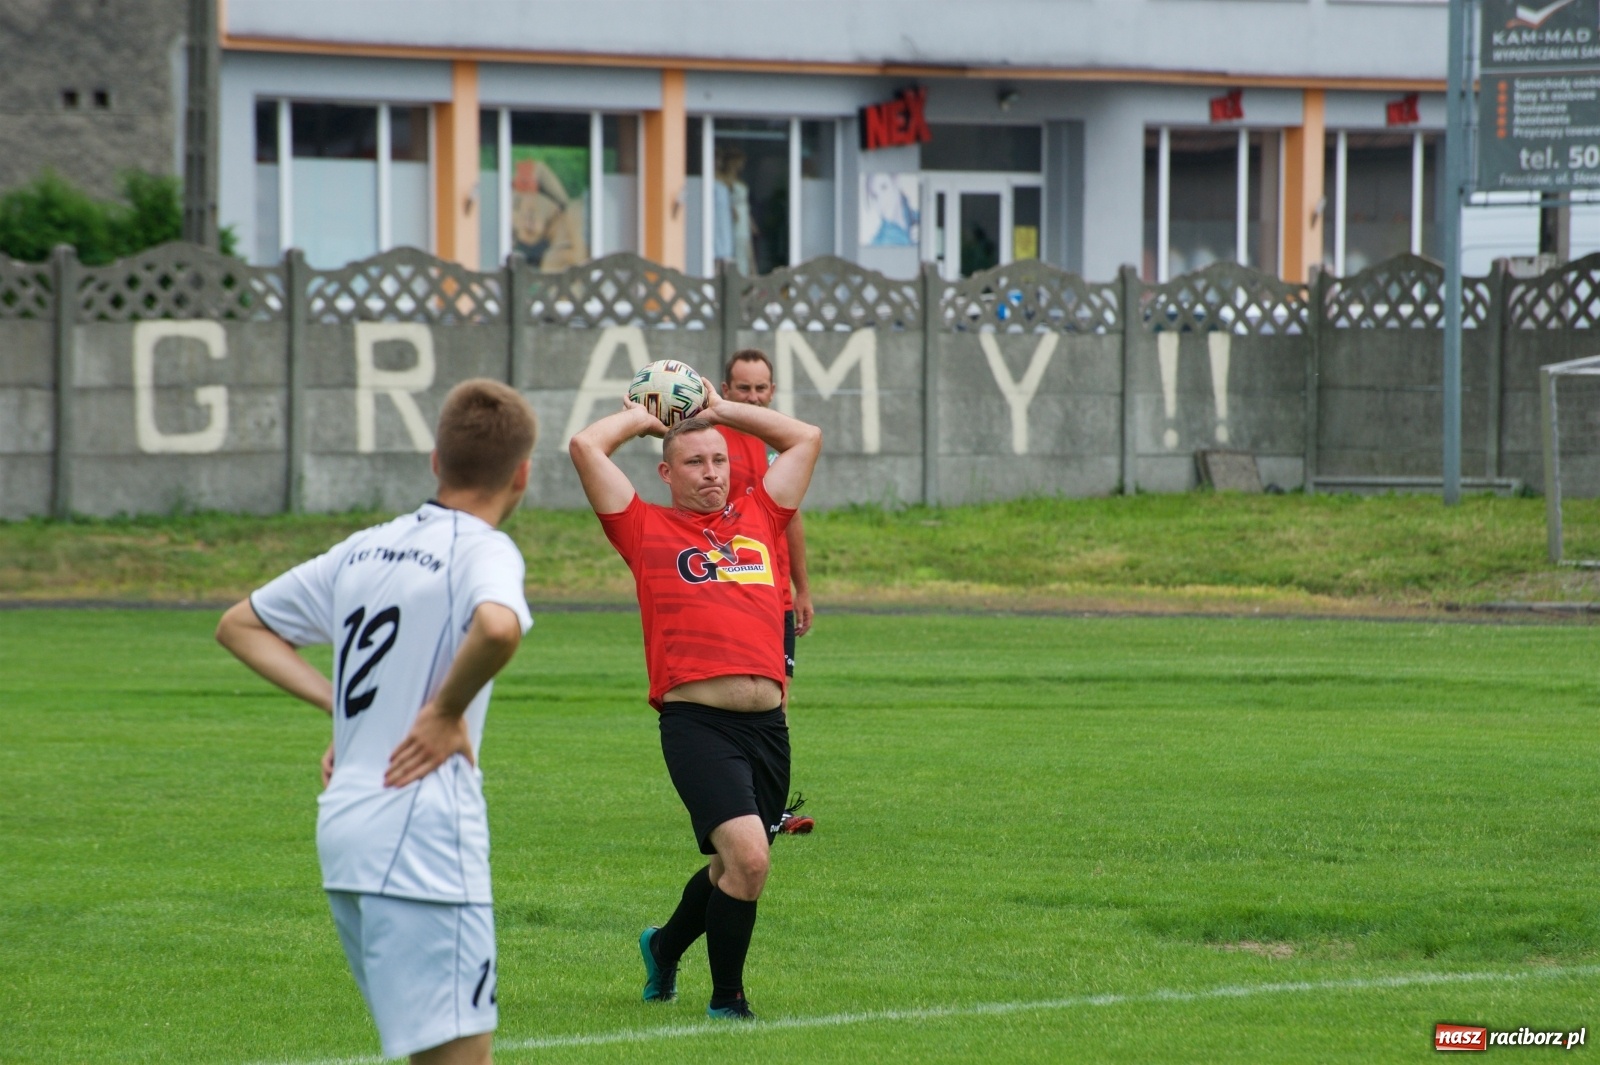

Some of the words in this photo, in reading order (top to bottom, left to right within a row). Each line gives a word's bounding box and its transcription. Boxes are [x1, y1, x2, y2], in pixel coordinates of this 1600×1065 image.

[864, 84, 932, 151] NEX
[1519, 146, 1560, 170] tel.
[1568, 143, 1600, 169] 50
[337, 605, 401, 719] 12
